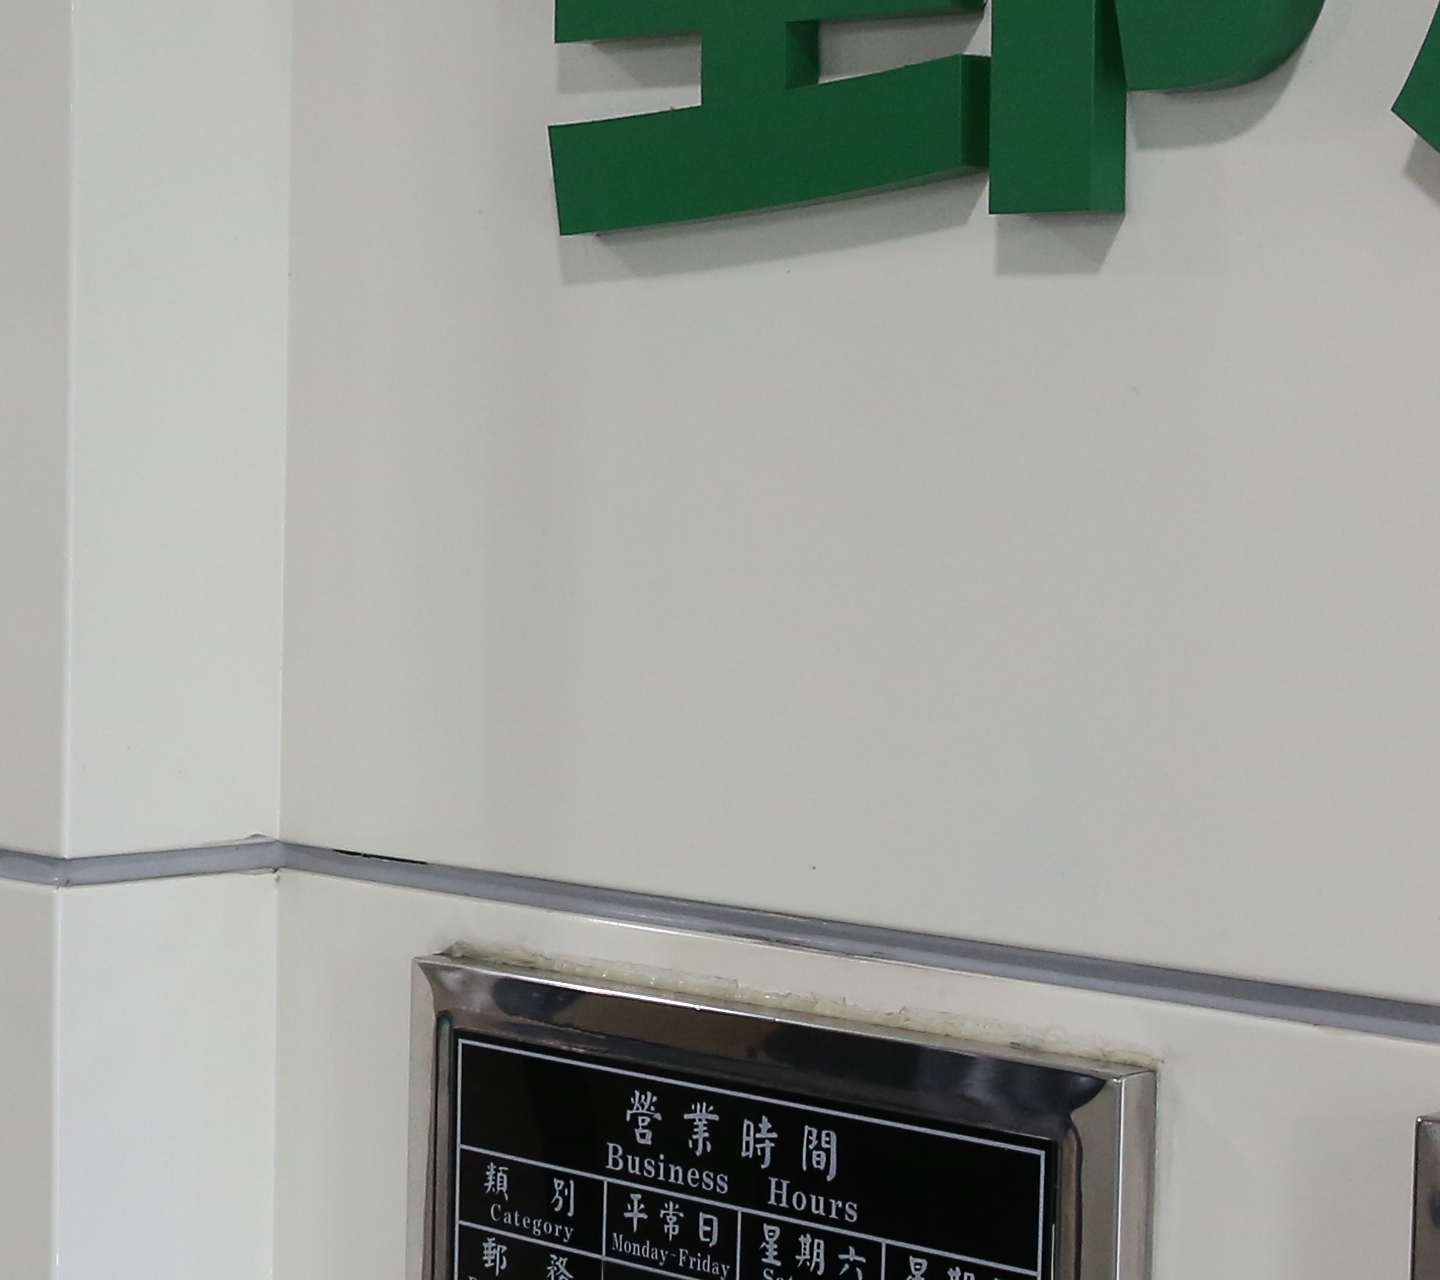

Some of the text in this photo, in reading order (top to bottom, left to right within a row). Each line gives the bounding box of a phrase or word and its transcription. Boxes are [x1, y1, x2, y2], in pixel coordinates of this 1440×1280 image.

[625, 1091, 839, 1182] 營業時間
[484, 1162, 575, 1216] 類別
[605, 1142, 859, 1224] Business Hours
[490, 1204, 574, 1242] Category
[623, 1193, 719, 1247] 平常日
[612, 1233, 730, 1280] Monday-Friday
[759, 1224, 867, 1279] 星期六
